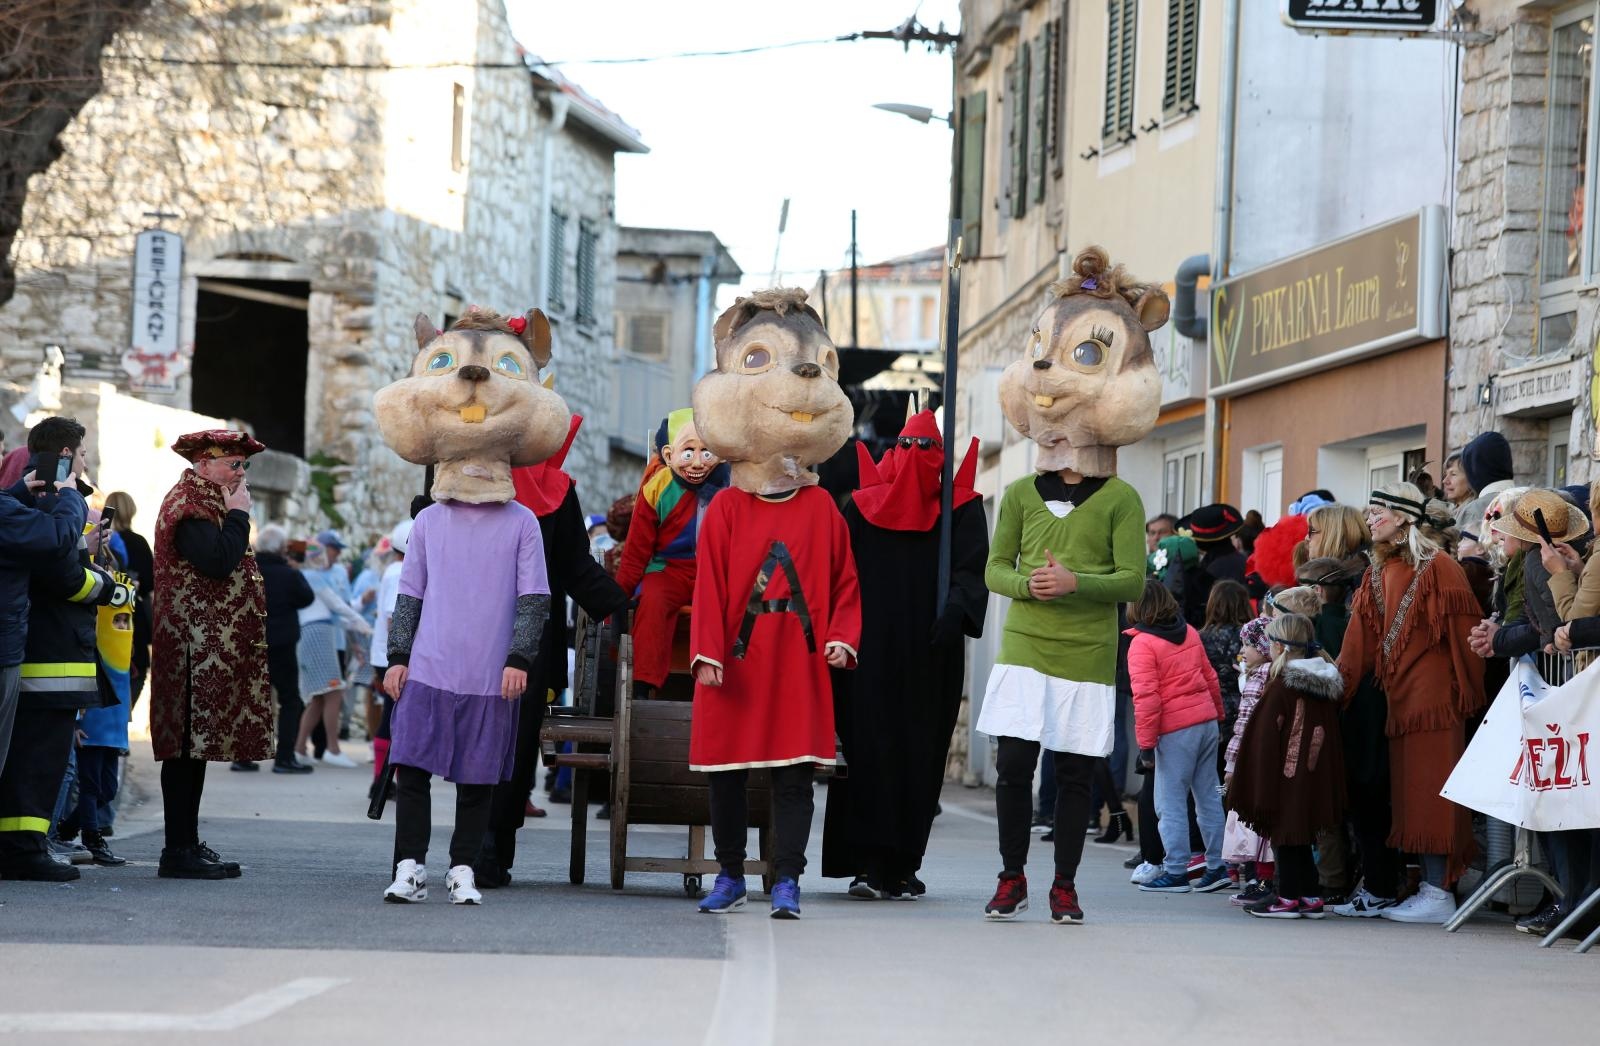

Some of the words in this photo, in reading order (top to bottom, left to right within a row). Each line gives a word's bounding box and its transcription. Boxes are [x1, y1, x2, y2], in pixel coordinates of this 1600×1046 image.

[1251, 271, 1330, 356] PEKARNA
[1334, 266, 1380, 331] Laura
[733, 541, 816, 660] A
